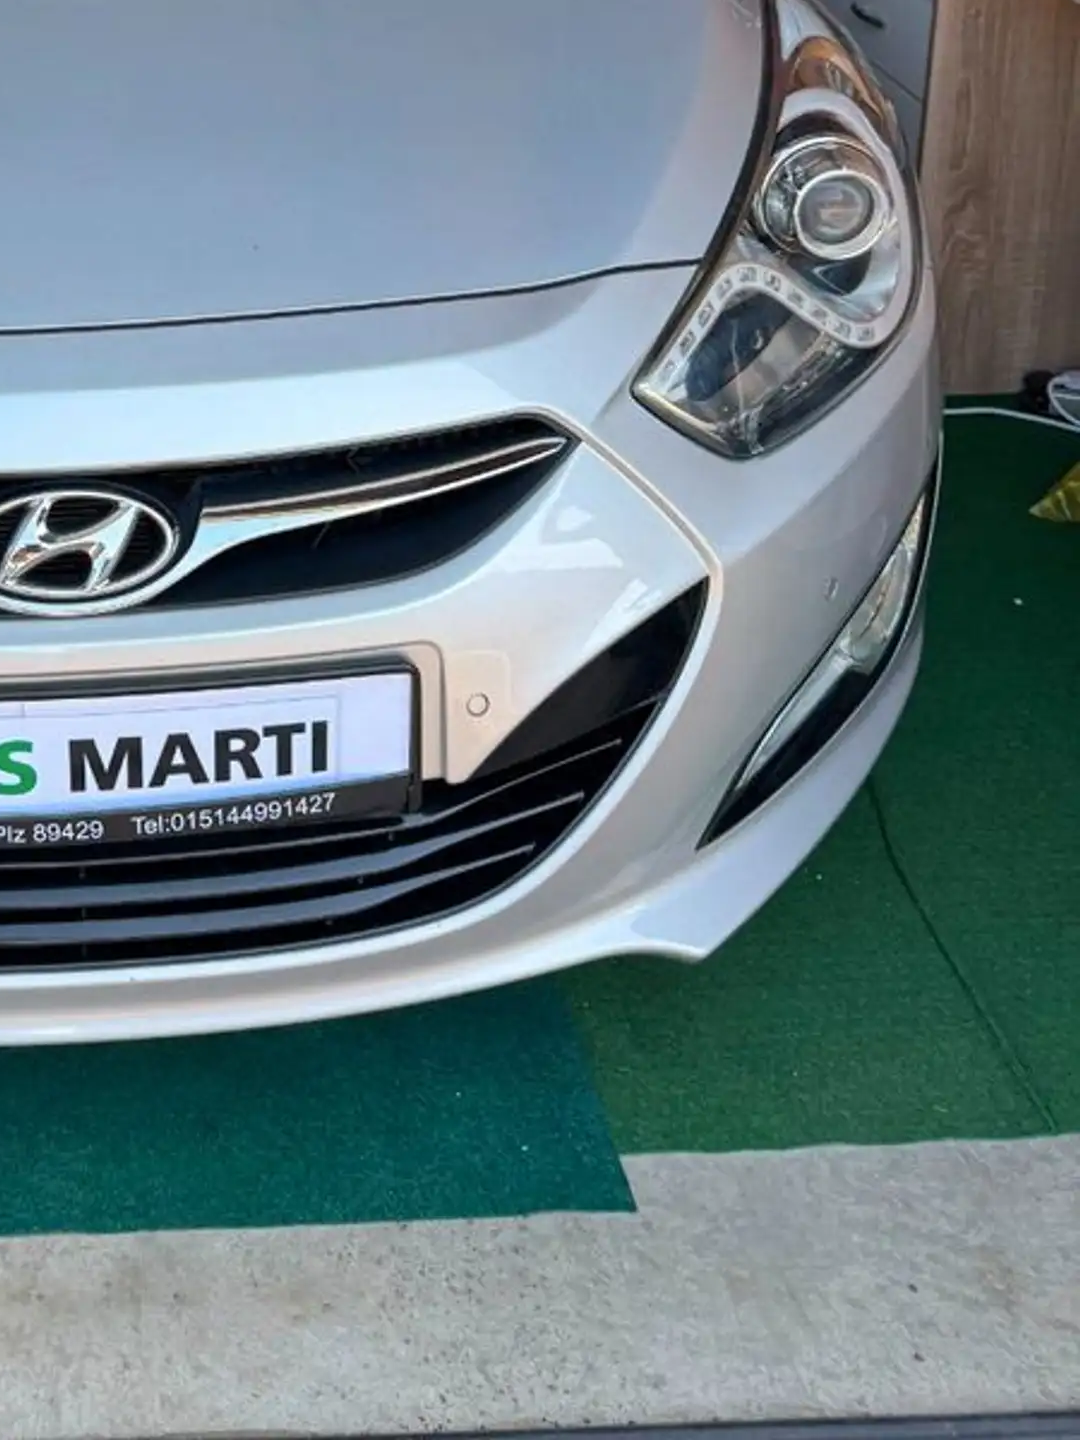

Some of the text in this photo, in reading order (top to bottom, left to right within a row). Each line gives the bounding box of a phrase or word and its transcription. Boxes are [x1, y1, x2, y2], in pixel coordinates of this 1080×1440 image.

[68, 720, 328, 793] MARTI
[32, 819, 104, 843] 89429
[130, 791, 336, 836] Tel:015144991427
